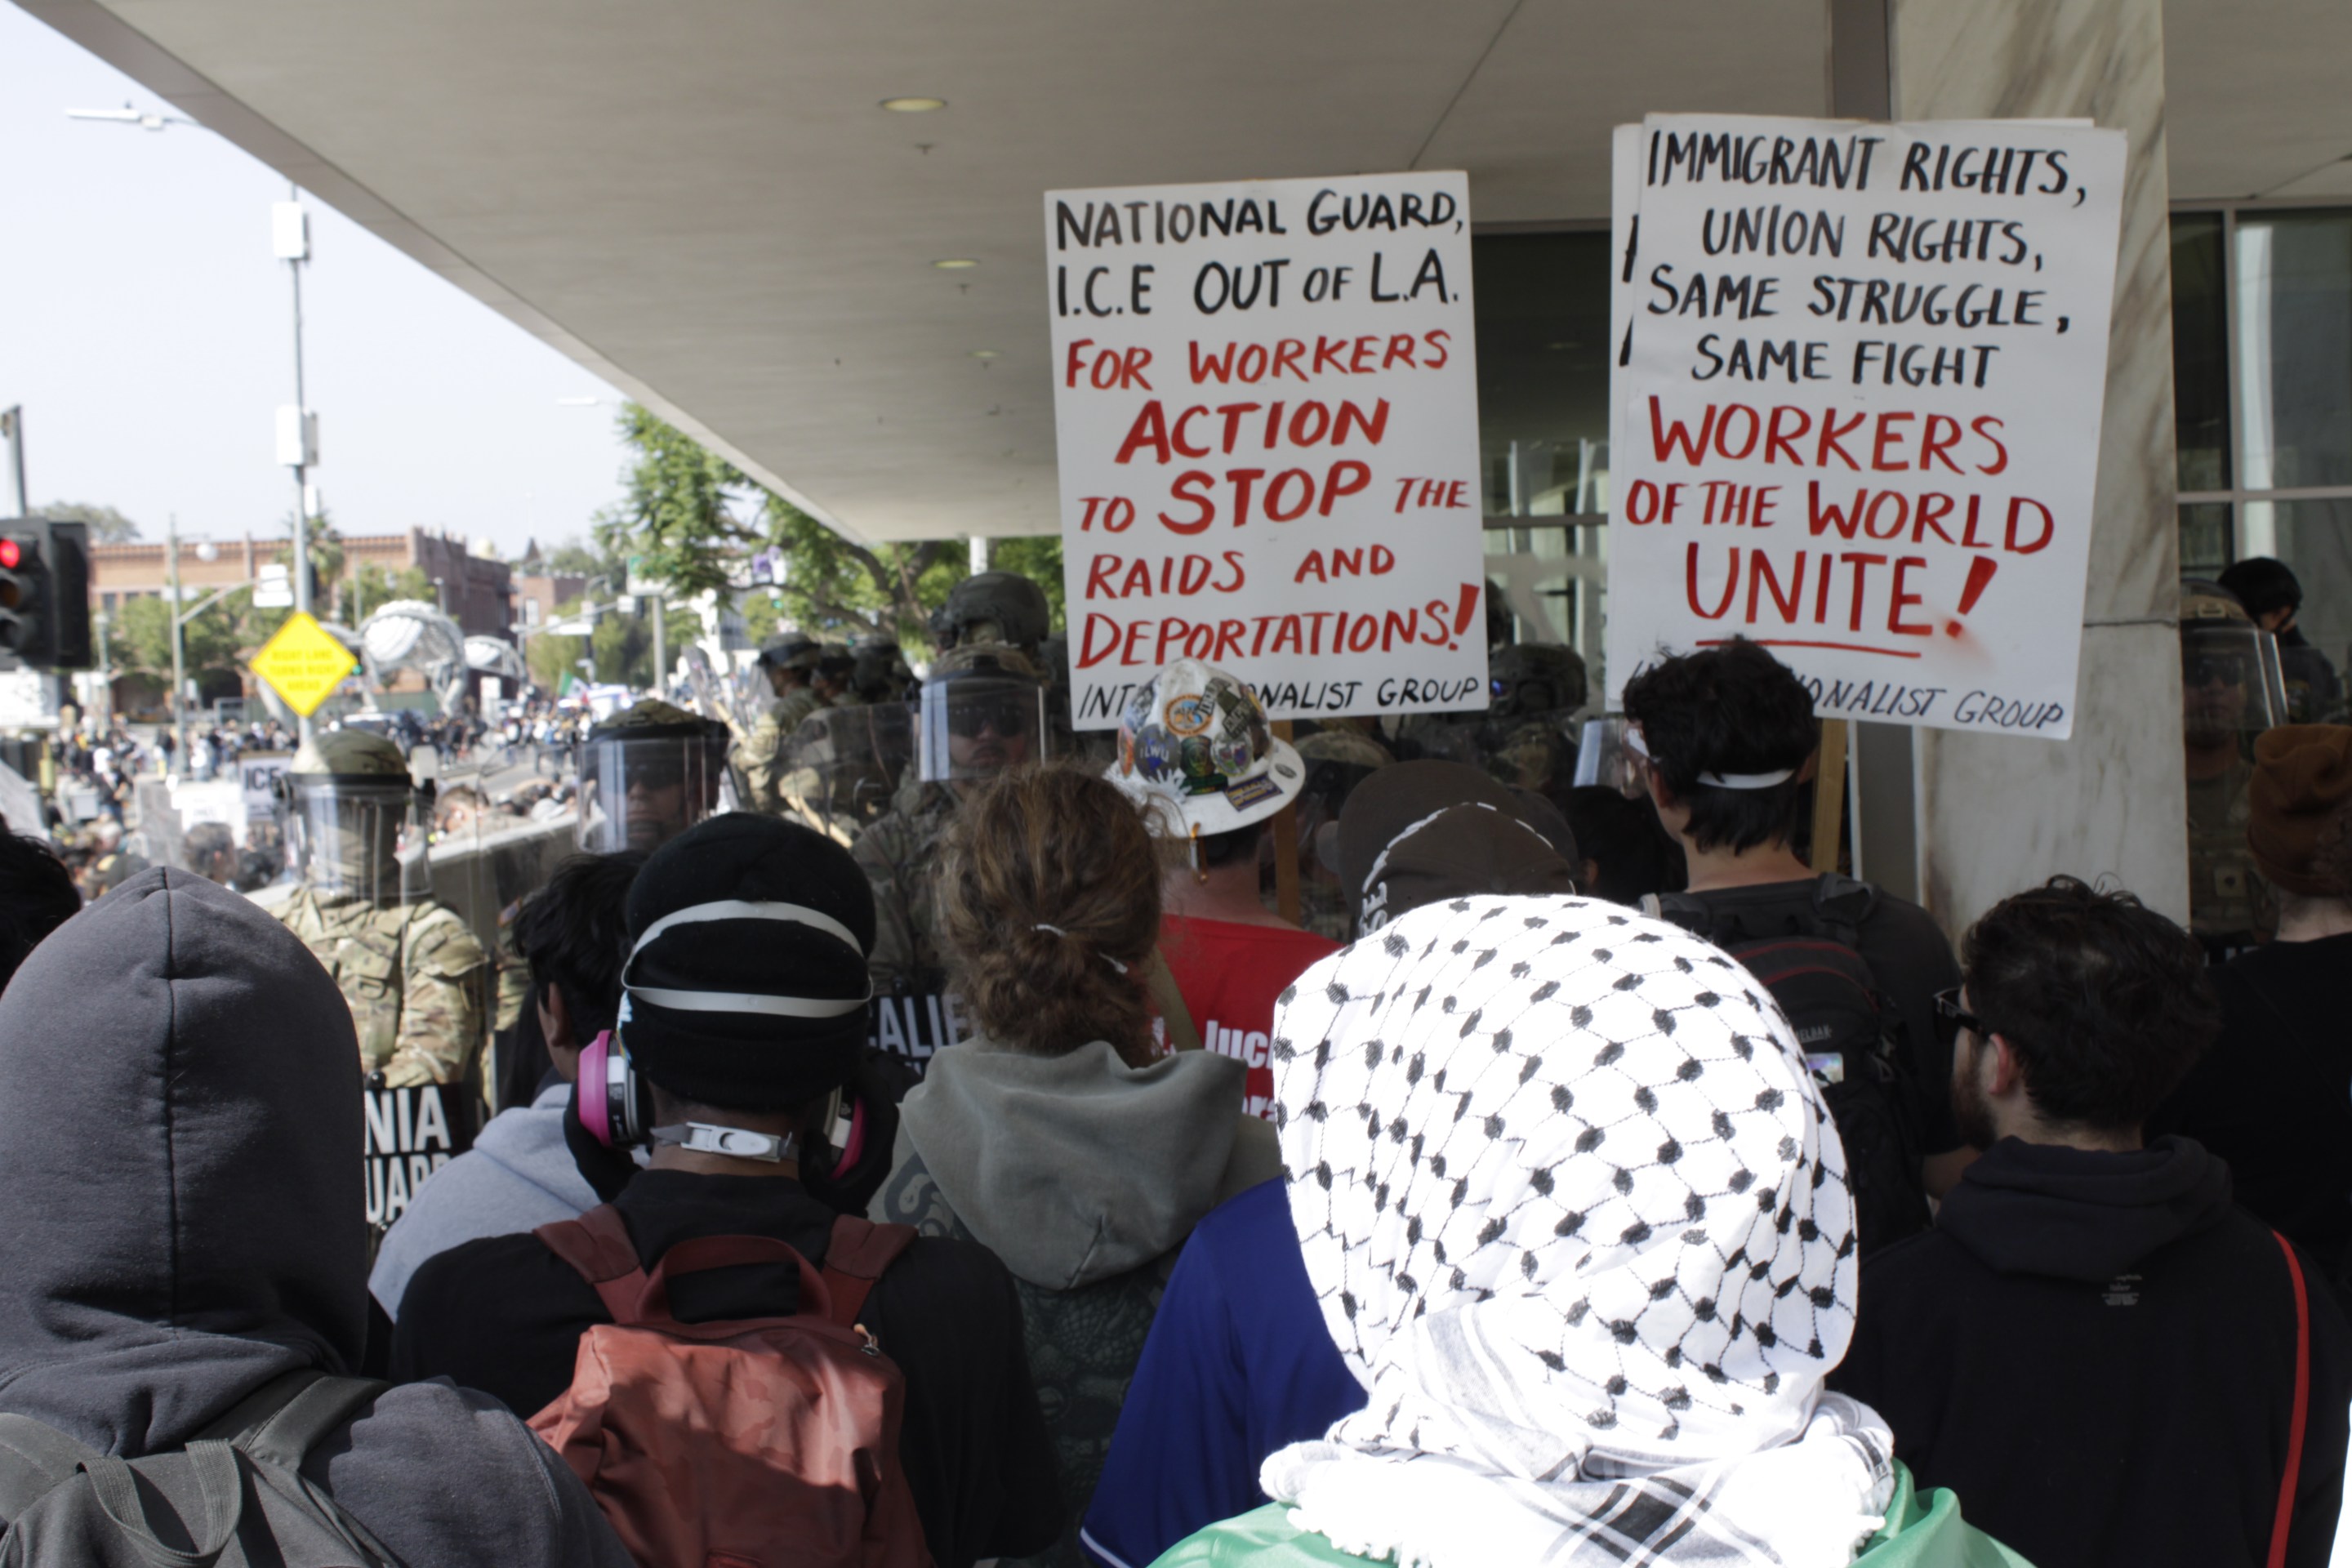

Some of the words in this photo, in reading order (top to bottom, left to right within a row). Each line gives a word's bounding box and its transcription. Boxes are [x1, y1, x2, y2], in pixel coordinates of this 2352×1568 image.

[1647, 130, 1885, 190] IMMIGRANT
[1900, 141, 2087, 207] RIGHTS,
[1056, 198, 1287, 250] NATIONAL
[1307, 189, 1463, 235] GUARD,
[1702, 204, 1846, 259] UNION
[1867, 212, 2044, 273] RIGHTS,
[1058, 264, 1156, 317] I.C.E
[1193, 258, 1291, 314] OUT
[1303, 267, 1354, 302] OF
[1370, 247, 1459, 304] L.A.
[1647, 263, 1780, 320] SAME
[1807, 274, 2070, 335] STRUGGLE,
[1066, 338, 1153, 390] FOR
[1188, 329, 1451, 384] WORKERS
[1691, 333, 1833, 384] SAME
[1851, 340, 2001, 388] FIGHT
[1113, 397, 1391, 465] ACTION
[1648, 394, 2009, 476] WORKERS
[1077, 497, 1135, 533] TO
[1156, 461, 1372, 535] STOP
[1393, 477, 1472, 514] THE
[1624, 479, 1690, 526] OF
[1698, 480, 1784, 528] THE
[1807, 480, 2055, 555] WORLD
[1085, 551, 1245, 599] RAIDS
[1294, 544, 1395, 583] AND
[1686, 541, 1999, 639] UNITE!
[1075, 582, 1480, 669] DEPORTATIONS!
[1377, 677, 1479, 708] GROUP
[1953, 690, 2065, 729] GROUP
[1139, 744, 1169, 764] ILWU
[868, 994, 975, 1058] ALIF
[1795, 1024, 1832, 1044] ELBAK
